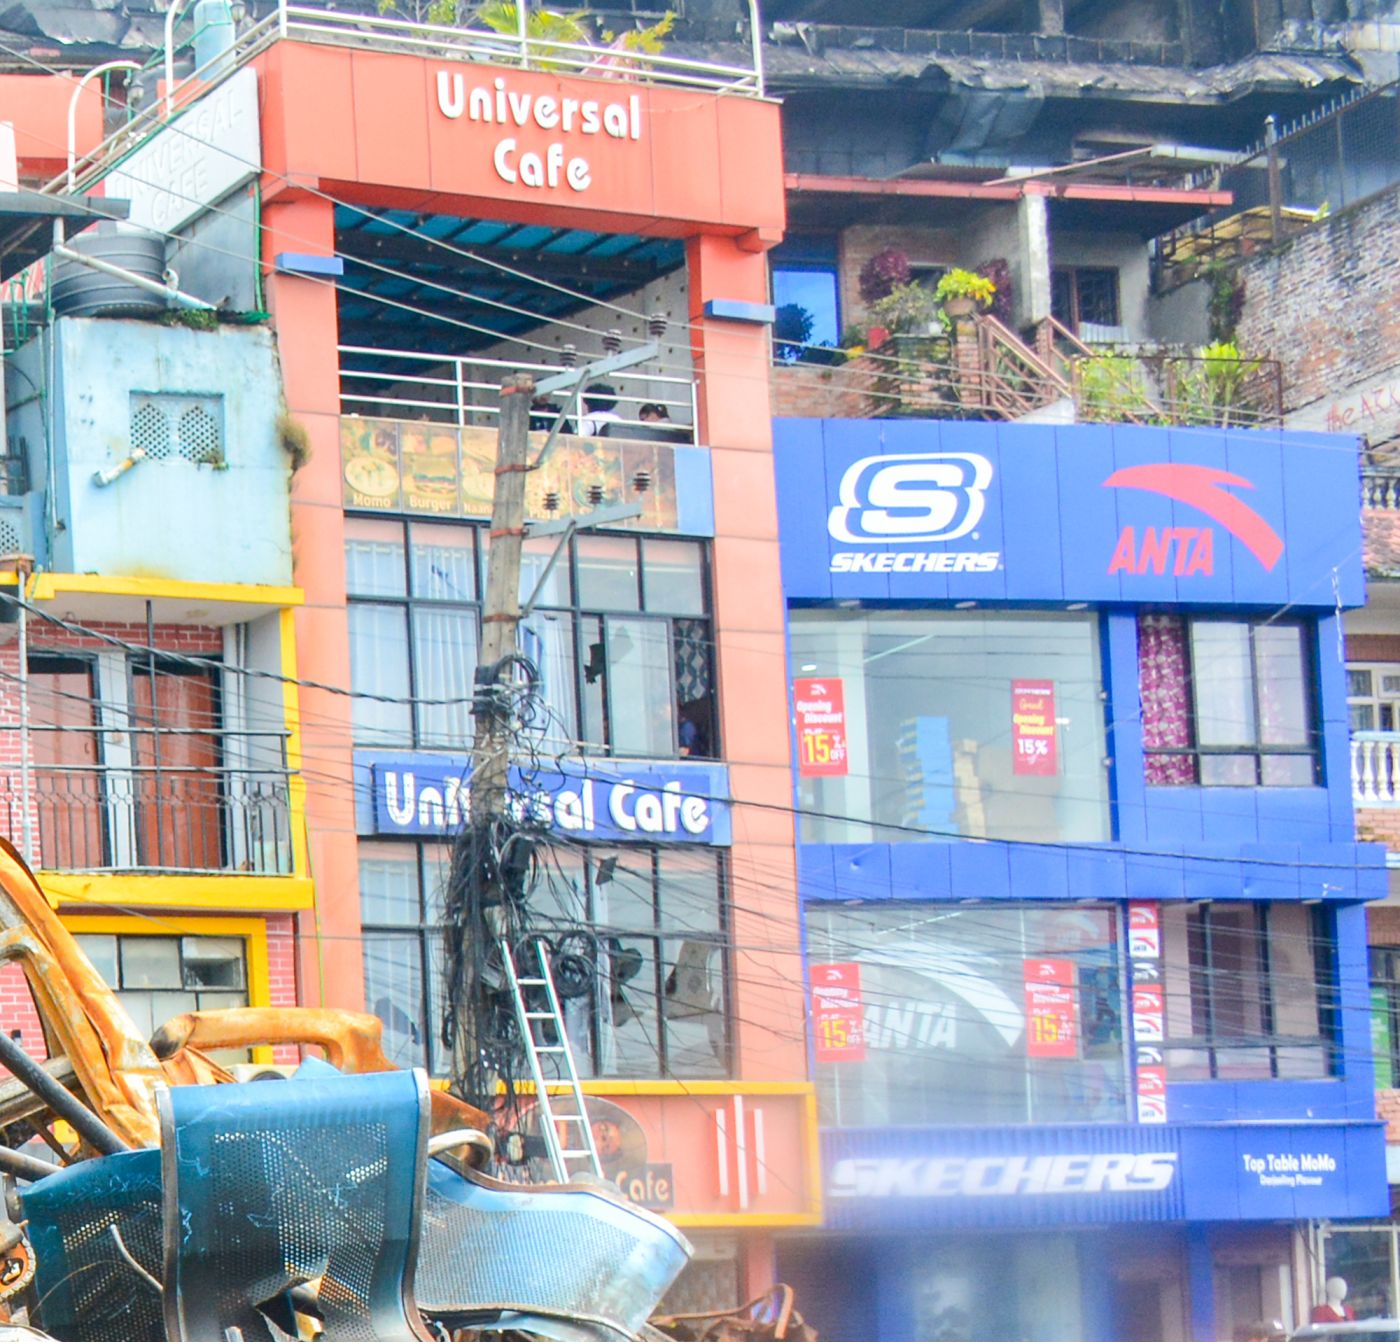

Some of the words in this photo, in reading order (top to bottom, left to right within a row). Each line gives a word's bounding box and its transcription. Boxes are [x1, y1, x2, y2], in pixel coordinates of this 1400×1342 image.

[437, 71, 640, 140] Universal
[494, 138, 592, 191] Cafe
[152, 156, 208, 226] CAFE
[353, 494, 391, 509] Momo
[409, 496, 453, 512] Burger
[829, 552, 1000, 573] SKECHERS
[1107, 525, 1215, 576] ANTA
[804, 734, 830, 763] 15
[1018, 738, 1048, 755] 15%
[609, 779, 709, 834] Cafe
[820, 1019, 847, 1048] 15
[862, 1002, 957, 1048] ANTA
[1032, 1014, 1057, 1042] 15
[830, 1153, 1178, 1197] SKECHERS
[1242, 1154, 1266, 1174] Top
[1267, 1153, 1299, 1172] Table
[1300, 1153, 1336, 1172] MoMo
[615, 1170, 670, 1203] Cafe
